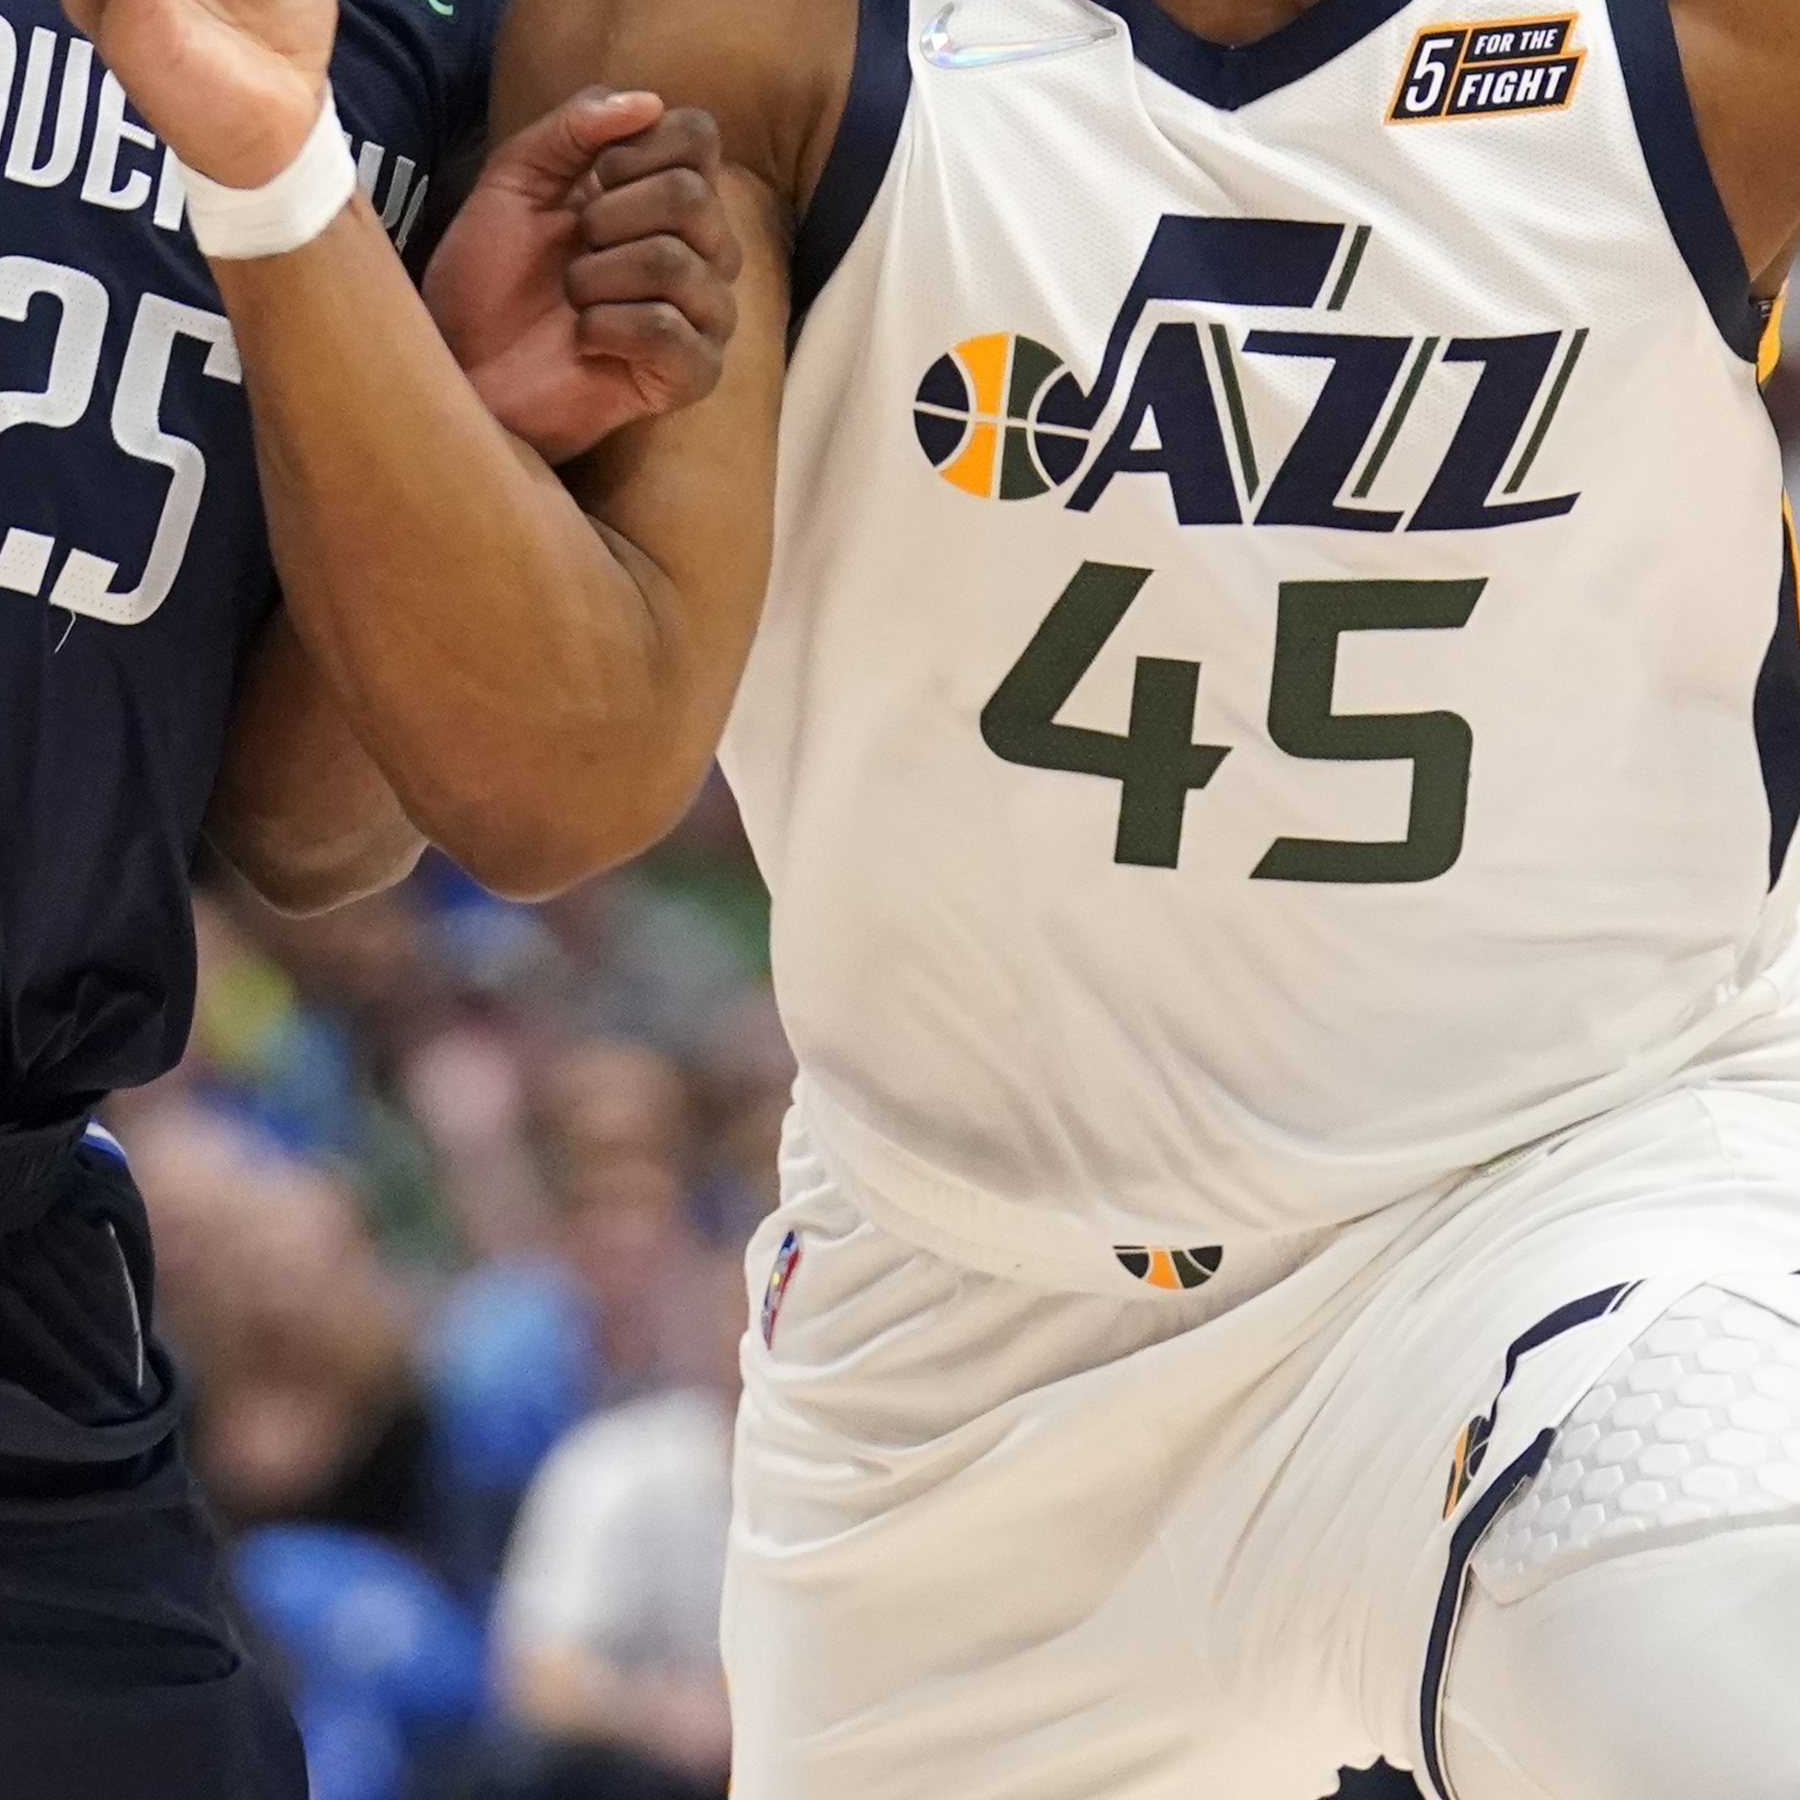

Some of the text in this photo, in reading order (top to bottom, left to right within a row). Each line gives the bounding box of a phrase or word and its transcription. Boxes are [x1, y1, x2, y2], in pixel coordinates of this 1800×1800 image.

[1405, 38, 1455, 113] 5
[1474, 28, 1559, 55] FOR THE
[1457, 66, 1568, 109] FIGHT
[913, 213, 1591, 533] JAZZ
[979, 559, 1490, 884] 45
